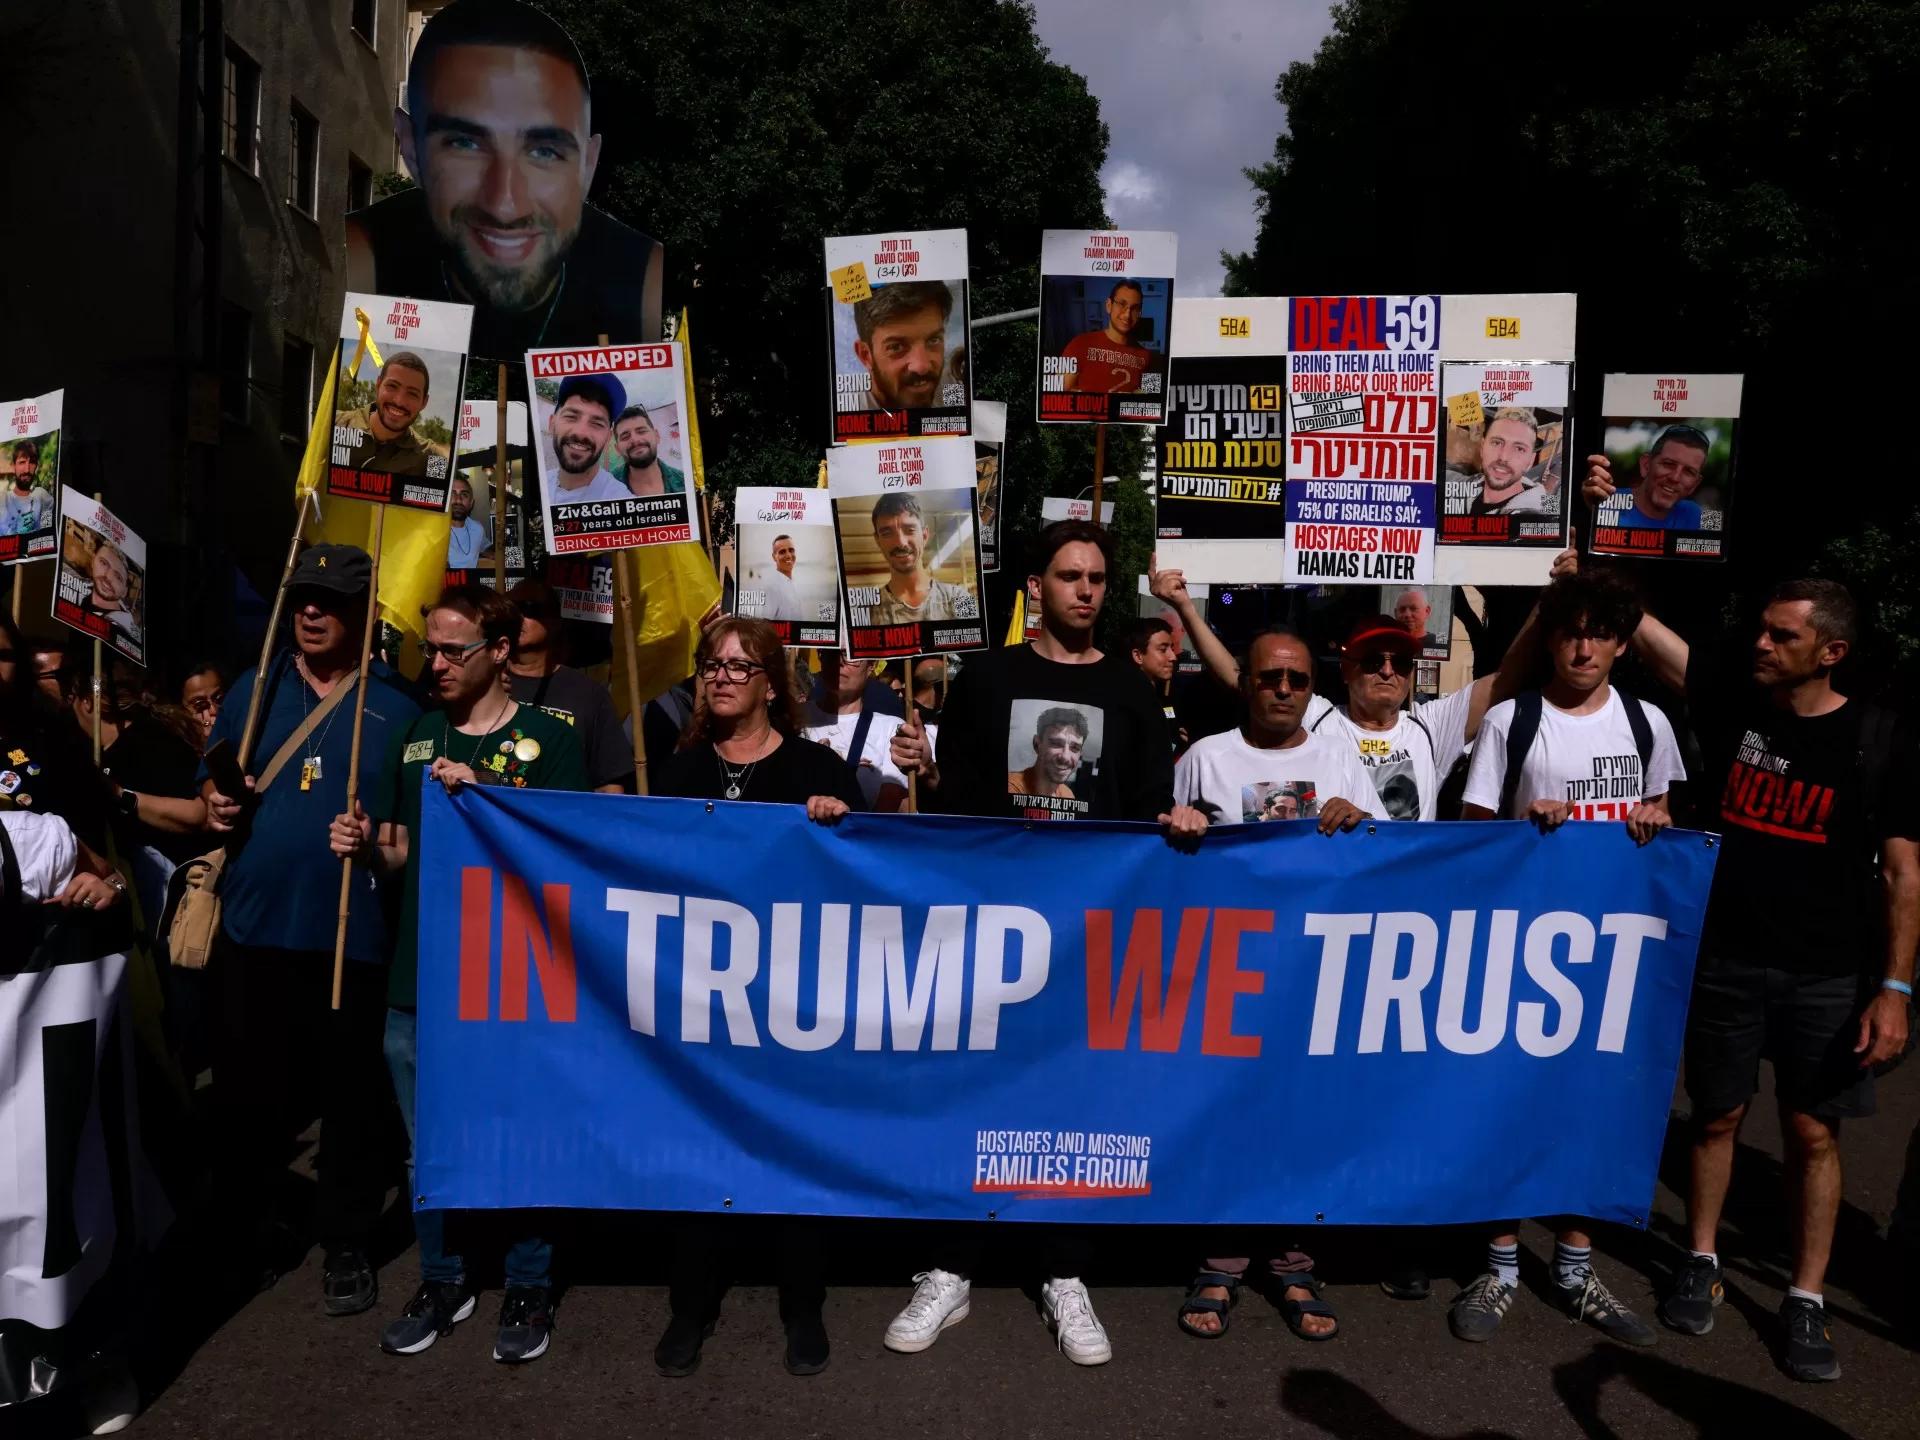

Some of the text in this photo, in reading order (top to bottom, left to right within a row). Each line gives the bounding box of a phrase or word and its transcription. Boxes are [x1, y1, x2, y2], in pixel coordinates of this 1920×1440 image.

[900, 240, 912, 250] דוד
[1113, 236, 1129, 247] תמיר
[874, 251, 920, 265] DAVID CUNIO
[1084, 248, 1134, 260] TAMIR NIMRODI
[877, 266, 899, 279] (34)
[1091, 260, 1110, 273] (20)
[387, 314, 420, 328] ITAY CHEN
[395, 326, 408, 341] (19)
[537, 348, 667, 376] KIDNAPPED
[1043, 356, 1078, 375] BRING
[1293, 353, 1435, 373] BRING THEM ALL HOME
[836, 374, 872, 393] BRING
[1043, 375, 1064, 392] HIM
[1293, 373, 1435, 393] BRING BACK OUR HOPE
[1481, 381, 1533, 392] ELKANA BOHBOT
[836, 394, 860, 412] HIM
[1042, 393, 1108, 414] HOME NOW!
[1251, 386, 1278, 410] 19
[1482, 392, 1497, 406] 36
[1653, 390, 1688, 401] TAL HAIMI
[1119, 408, 1161, 418] FAMILIES FORUM
[1312, 401, 1344, 415] בריאות
[1363, 392, 1436, 433] כולם
[1662, 400, 1677, 413] (42)
[837, 409, 908, 434] HOME NOW!
[921, 422, 967, 433] FAMILIES FORUM
[1184, 411, 1283, 440] בשבי הם
[1298, 410, 1361, 431] למען החטופים
[333, 426, 363, 448] BRING
[331, 445, 351, 467] HIM
[898, 446, 922, 458] אריאל
[1164, 440, 1282, 469] סכנת מוות
[1291, 438, 1435, 481] הומניטרי
[878, 459, 924, 475] ARIEL CUNIO
[330, 467, 392, 495] HOME NOW!
[883, 475, 904, 489] (27)
[1445, 481, 1478, 498] BRING
[1305, 481, 1415, 506] PRESIDENT TRUMP,
[557, 498, 681, 520] Ziv&Gali Berman
[772, 501, 807, 511] OMRI MIRAN
[1297, 500, 1421, 524] 75% OF ISRAELIS SAY:
[1444, 498, 1465, 515] HIM
[582, 520, 612, 535] years
[616, 517, 633, 527] old
[636, 513, 677, 525] Israelis
[1443, 515, 1509, 533] HOME NOW!
[1596, 509, 1620, 526] HIM
[556, 528, 691, 552] BRING THEM HOME
[1295, 524, 1422, 555] HOSTAGES NOW
[1519, 528, 1542, 537] FAMILIES
[1594, 527, 1665, 550] HOME NOW!
[1676, 544, 1721, 555] FAMILIES FORUM
[1297, 551, 1415, 580] HAMAS LATER
[60, 572, 92, 595] BRING
[59, 584, 78, 605] HIM
[563, 590, 582, 601] THEM
[583, 592, 595, 602] ALL
[739, 590, 766, 606] BRING
[848, 587, 881, 607] BRING
[563, 600, 581, 610] BACK
[581, 602, 596, 612] OUR
[57, 599, 110, 635] HOME NOW!
[849, 607, 871, 627] HIM
[852, 623, 921, 649] HOME NOW!
[934, 634, 982, 646] FAMILIES FORUM
[407, 742, 434, 760] 584
[1736, 744, 1791, 775] THEM HOME
[1592, 754, 1639, 778] מחזירים
[1566, 775, 1641, 801] אותם הביתה
[1721, 761, 1835, 833] NOW!
[458, 866, 1669, 1058] IN TRUMP WE TRUST
[976, 1130, 1151, 1158] HOSTAGES AND MISSING
[975, 1154, 1149, 1189] FAMILIES FORUM
